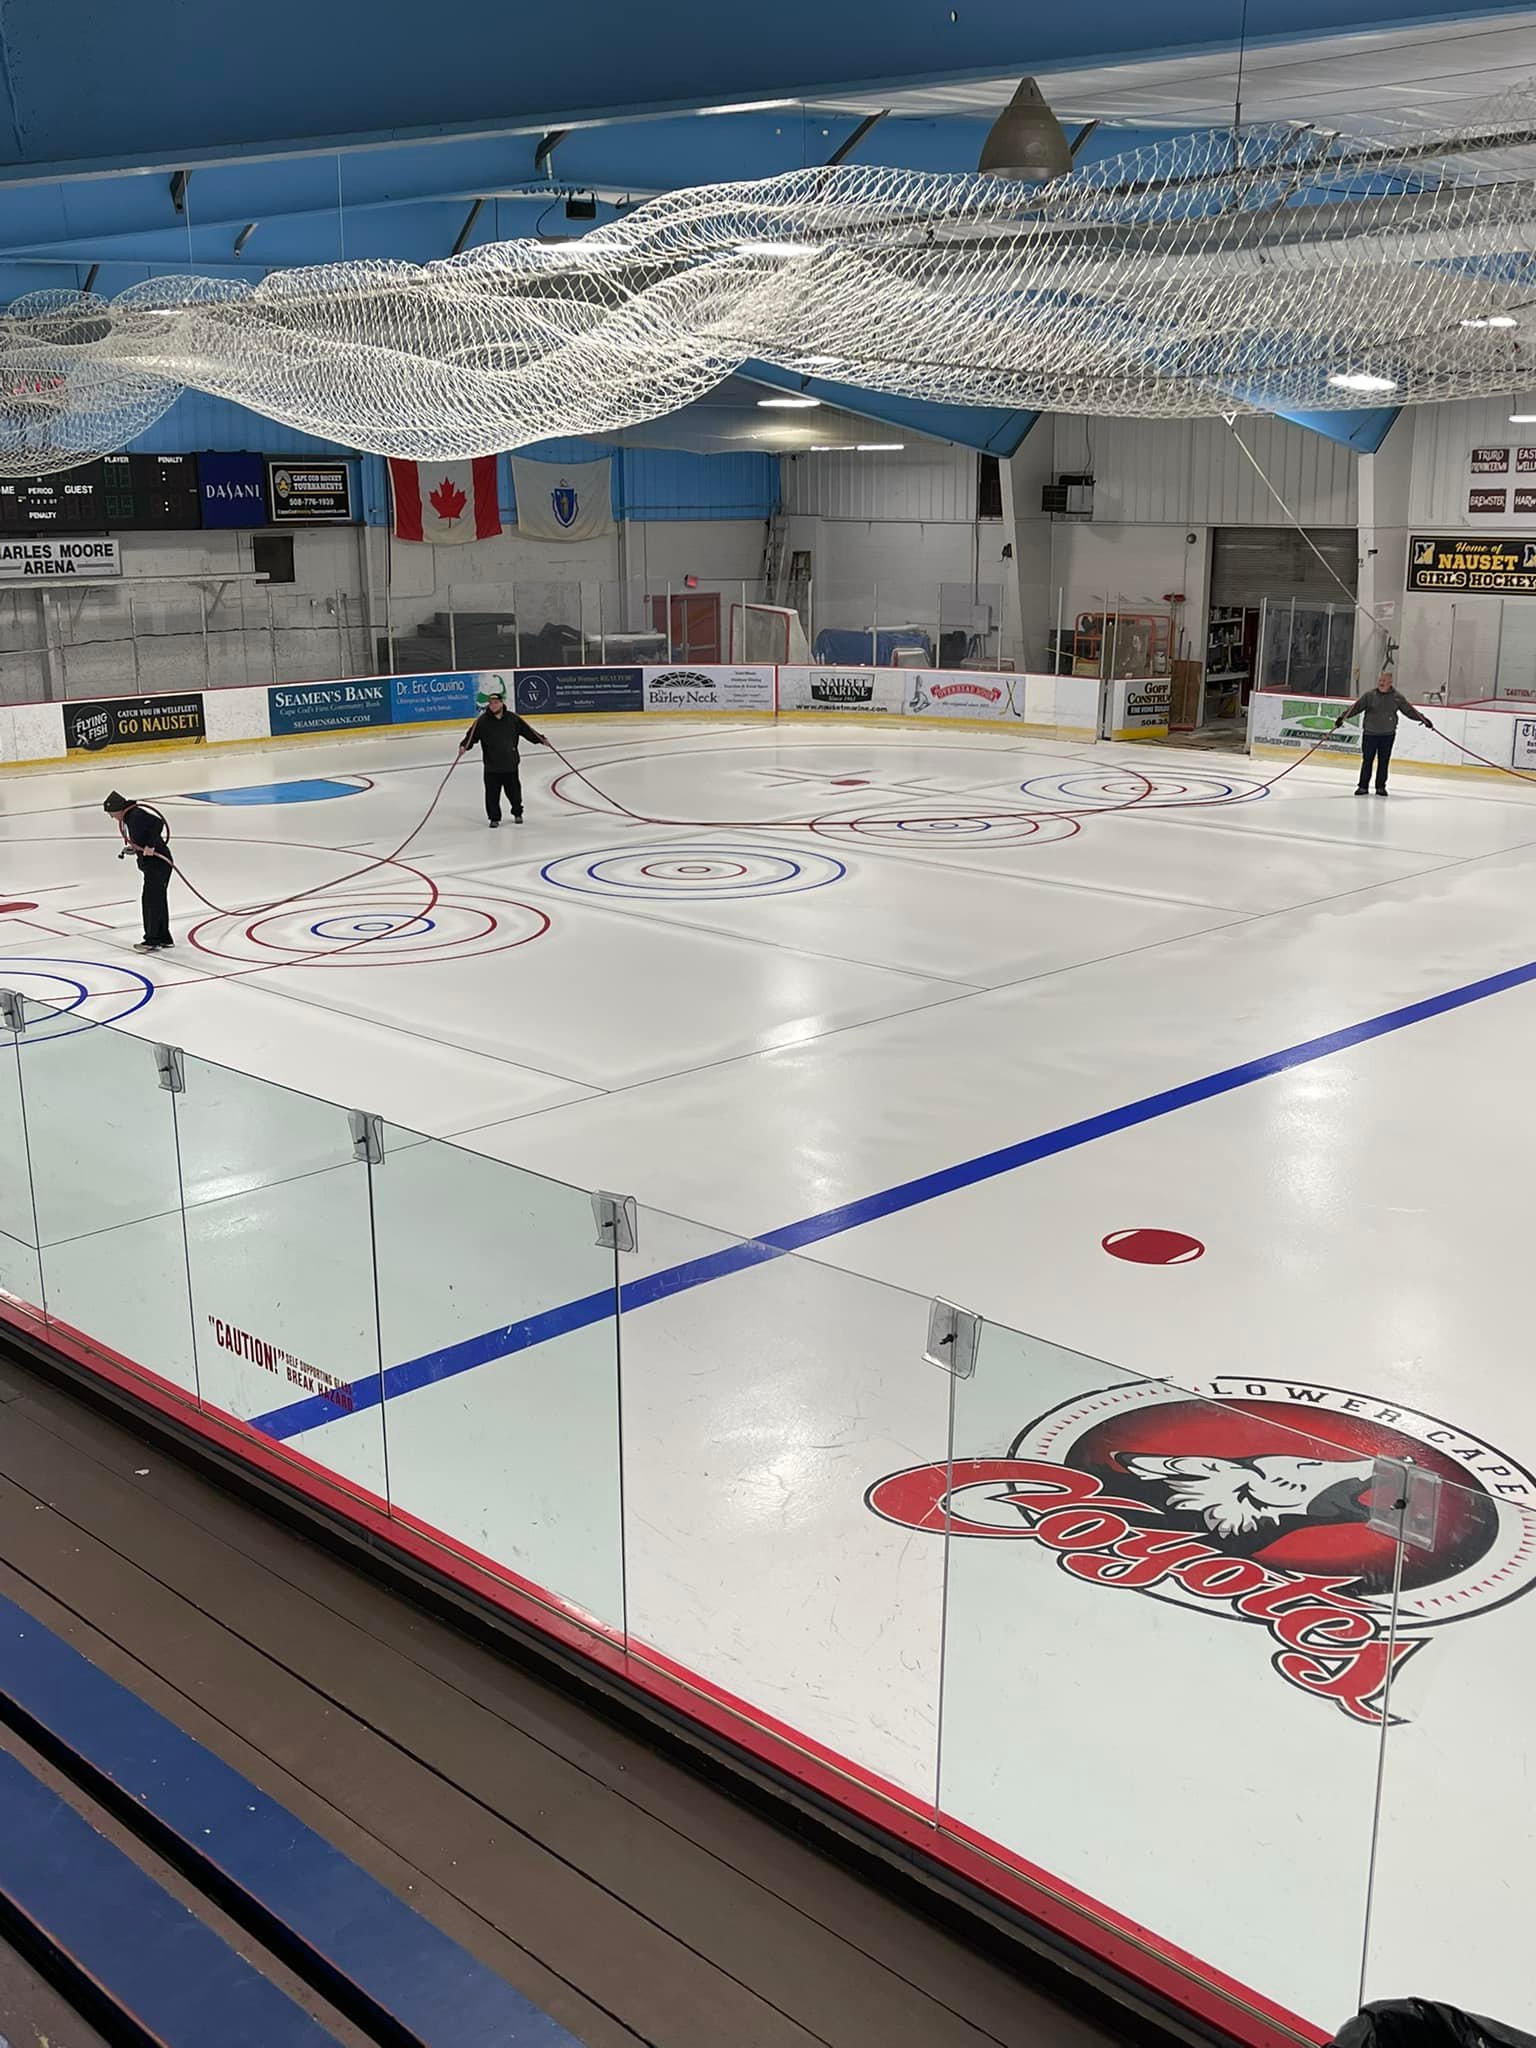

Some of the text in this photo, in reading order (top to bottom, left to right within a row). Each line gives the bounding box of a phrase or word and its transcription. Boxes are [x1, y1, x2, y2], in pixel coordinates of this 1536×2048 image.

[104, 456, 129, 464] PLAYER
[158, 456, 183, 464] PENALTY
[1478, 450, 1504, 461] TRURO
[1518, 449, 1536, 460] EAST
[64, 485, 93, 495] GUEST
[206, 480, 260, 500] DASANI
[1470, 495, 1505, 507] BREWSTER
[0, 543, 114, 560] ARLES MOORE
[1455, 542, 1503, 556] Home of
[23, 560, 76, 574] ARENA
[1438, 554, 1518, 571] NAUSET
[1417, 571, 1536, 589] GIRLS HOCKEY
[396, 681, 410, 696] Dr.
[820, 678, 868, 687] NAUSET
[1144, 682, 1169, 695] GOFF
[275, 689, 342, 708] SEAMEN'S
[345, 686, 384, 701] BANK
[649, 691, 685, 707] Barley
[687, 691, 718, 704] Neck
[818, 686, 869, 697] MARINE
[76, 712, 108, 733] FLYING
[118, 713, 200, 735] GO NAUSET!
[88, 724, 108, 739] FISH
[285, 1353, 299, 1369] SELF
[300, 1360, 332, 1384] SUPPORTING
[286, 1367, 354, 1412] BREAK HAZARD
[1208, 1381, 1530, 1497] LOWER CAPE
